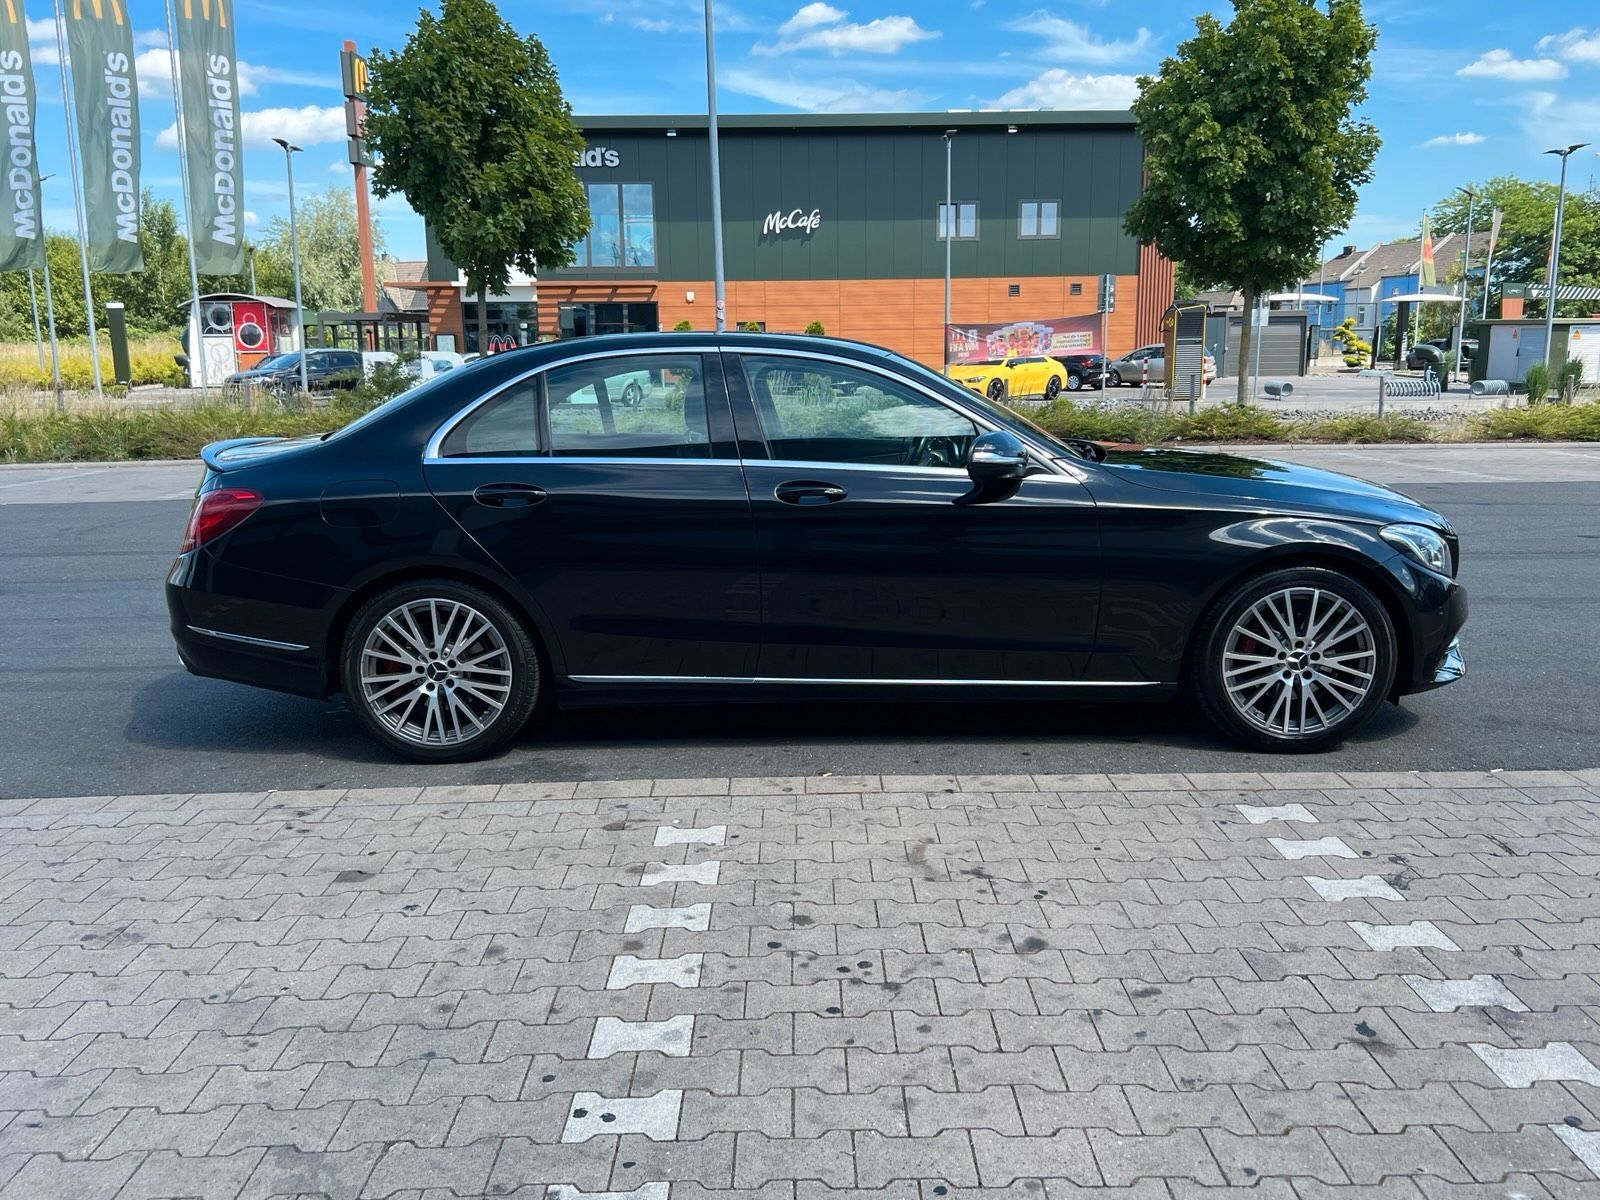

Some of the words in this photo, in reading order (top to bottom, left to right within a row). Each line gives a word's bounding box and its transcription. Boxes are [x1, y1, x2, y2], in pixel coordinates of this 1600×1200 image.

[0, 49, 36, 241] McDonald's
[104, 52, 138, 244] McDonald's
[207, 54, 236, 246] McDonald's
[763, 208, 821, 234] McCafé
